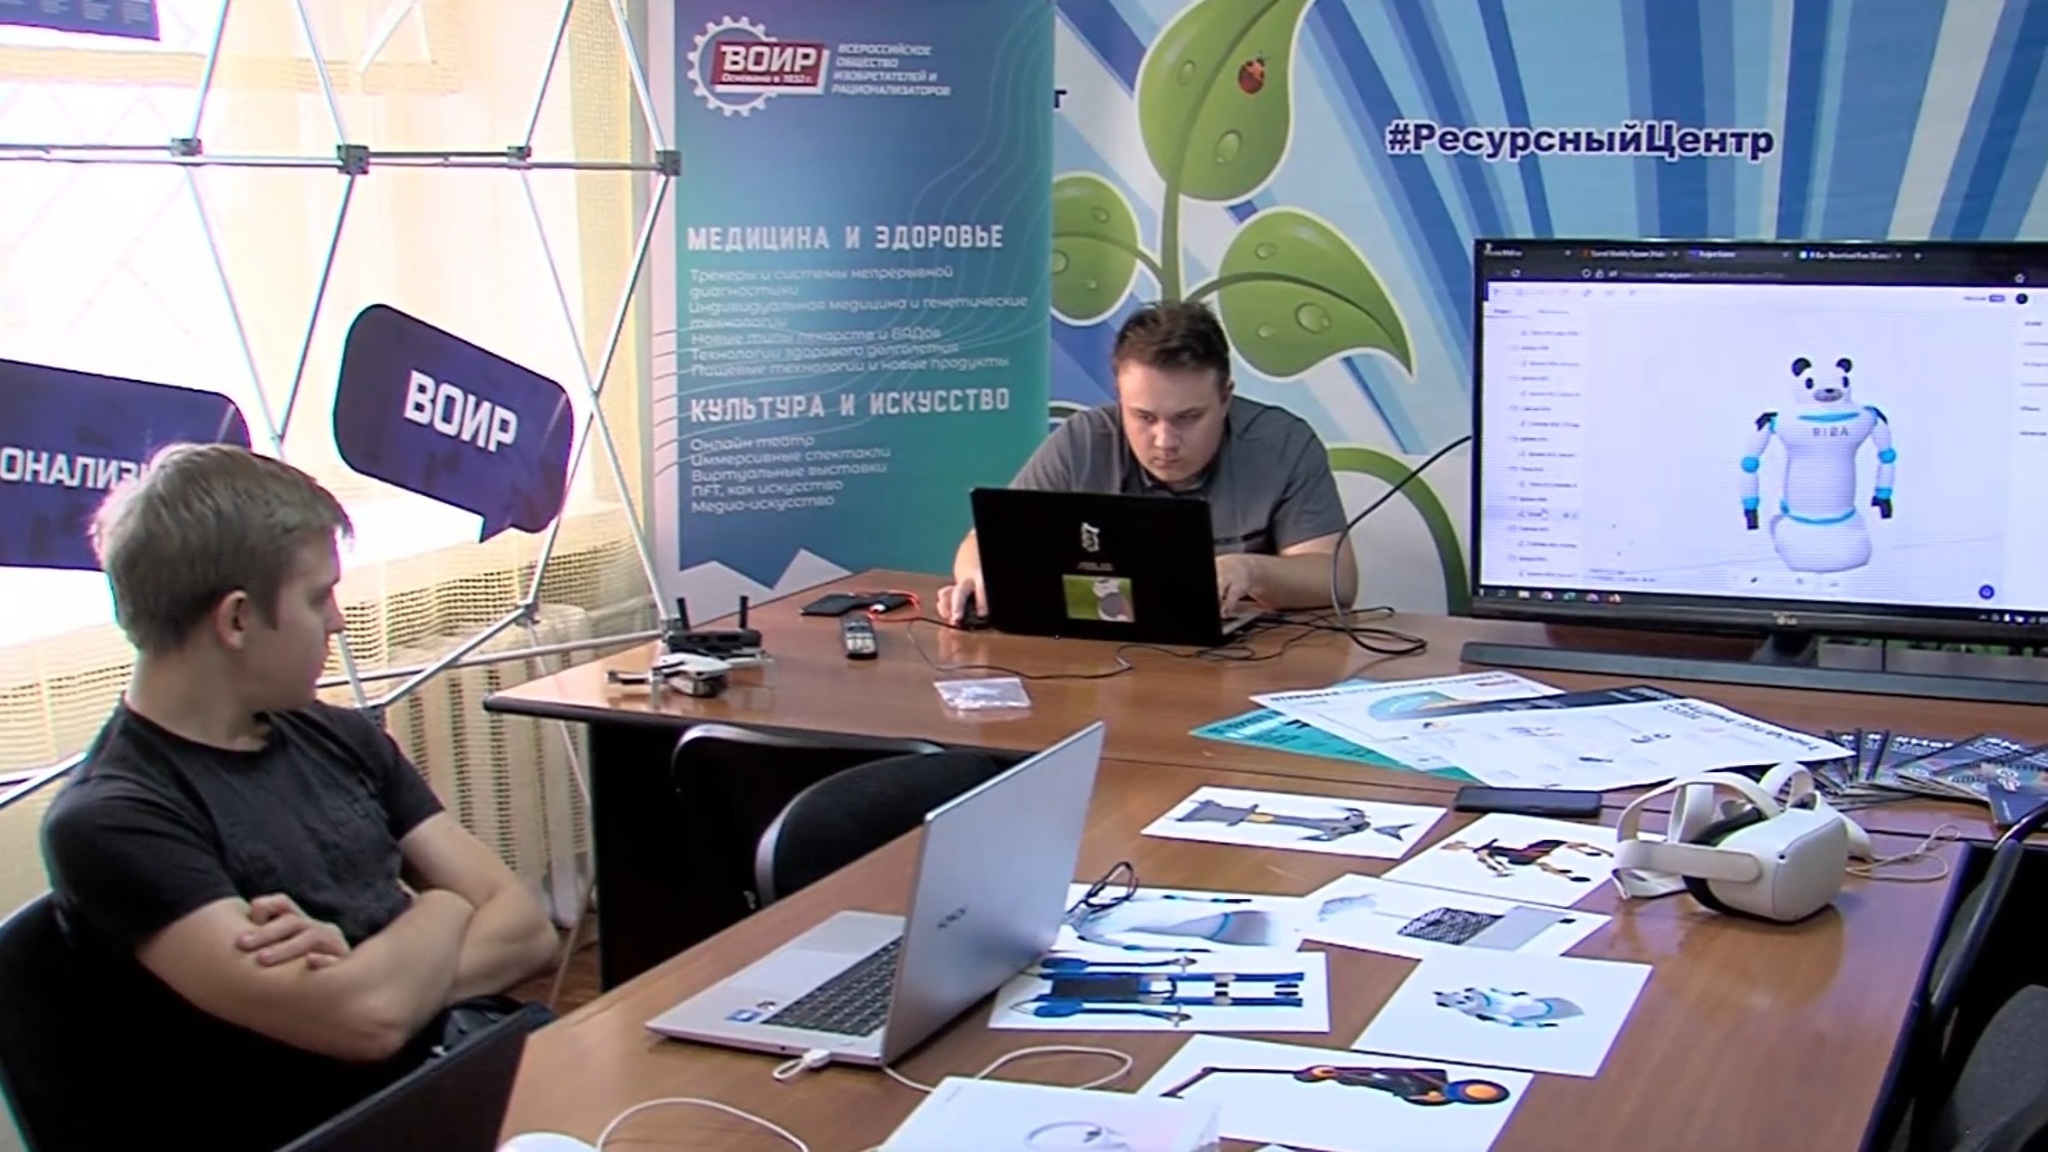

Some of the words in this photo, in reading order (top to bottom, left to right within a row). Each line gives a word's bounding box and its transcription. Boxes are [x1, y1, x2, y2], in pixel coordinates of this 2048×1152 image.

[720, 44, 817, 73] ВОИР
[838, 42, 932, 56] ВСЕРОССИЙСКОЕ
[836, 57, 898, 69] ОБЩЕСТВО
[834, 69, 926, 83] ИЗОБРЕТАТЕЛЕЙ
[832, 84, 951, 97] РАЦИОНАЛИЗАТОРОВ
[1387, 122, 1774, 161] #РесурсныйЦентр
[687, 227, 830, 252] МЕДИЦИНА
[846, 227, 860, 250] И
[875, 225, 1003, 251] ЗДОРОВЬЕ
[689, 269, 756, 283] Трекеры
[774, 270, 848, 280] системы
[851, 265, 953, 281] непрерывной
[689, 286, 798, 300] диагностики
[689, 301, 826, 316] Индивидуальная
[829, 298, 907, 312] медицина
[910, 299, 920, 309] и
[923, 296, 1028, 309] генетические
[891, 327, 942, 341] БАДов
[881, 359, 928, 371] новые
[931, 356, 1009, 371] продукты
[403, 368, 518, 454] ВОИР
[690, 394, 825, 423] КУЛЬТУРА
[840, 393, 855, 417] И
[870, 387, 1010, 415] ИСКУССТВО
[691, 437, 751, 452] Онлайн
[755, 435, 815, 449] театр
[691, 453, 800, 467] Иммерсивные
[805, 447, 891, 462] спектакли
[0, 446, 150, 490] ОНАЛИЗ
[691, 466, 804, 483] Виртуальные
[808, 463, 887, 476] выставки
[727, 484, 755, 495] как
[758, 480, 843, 496] искусство
[691, 495, 836, 515] Медиа-искусство
